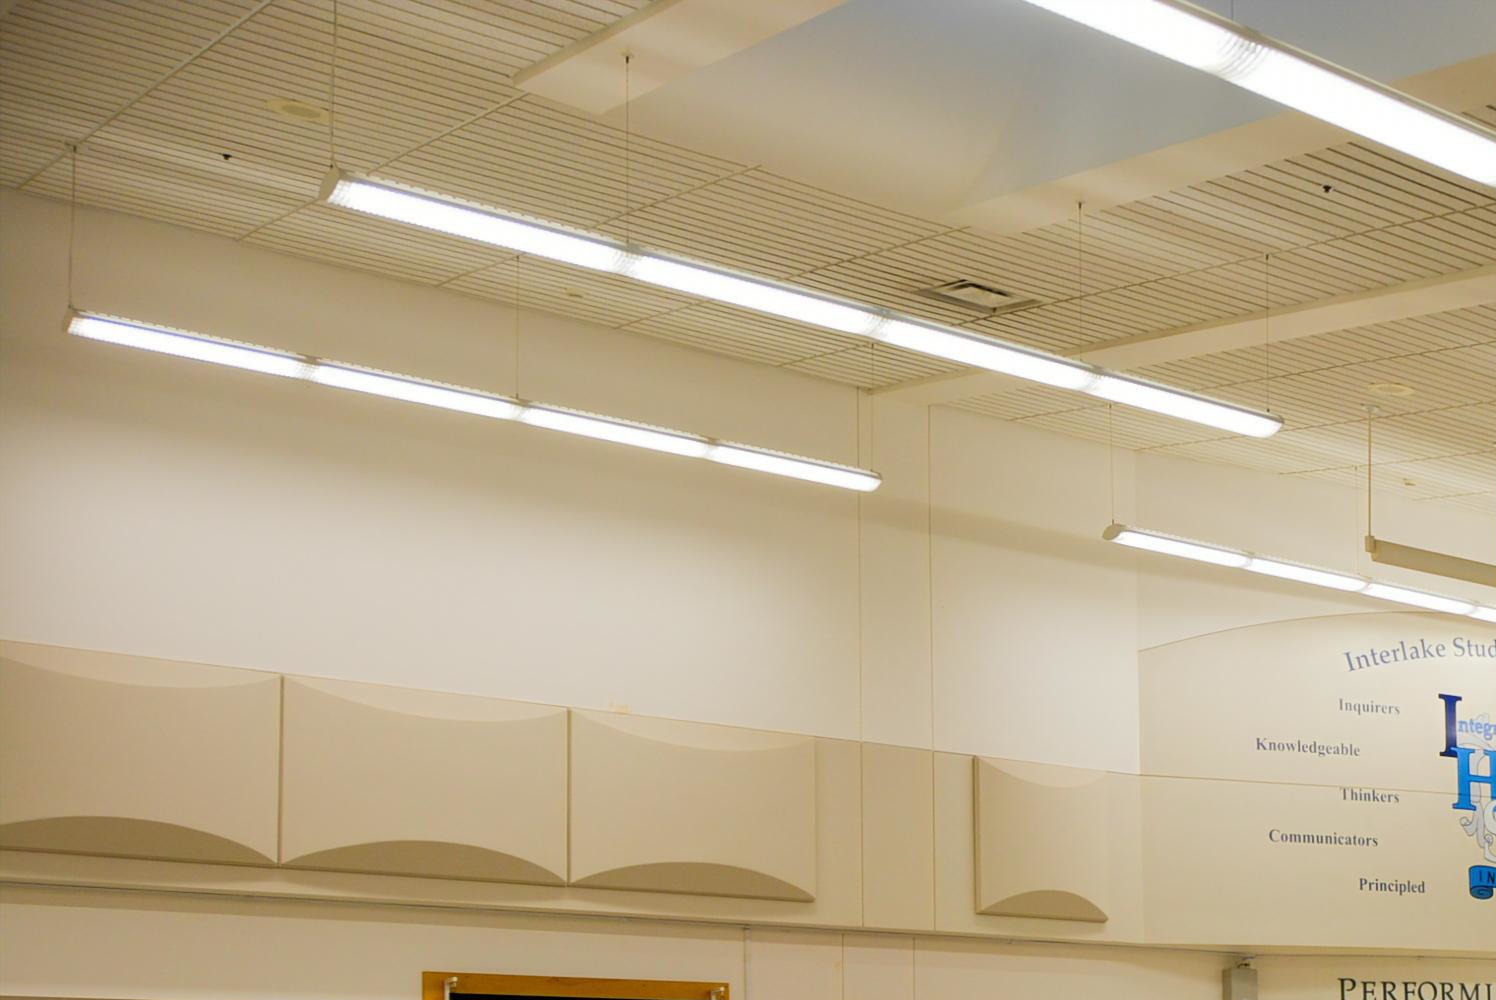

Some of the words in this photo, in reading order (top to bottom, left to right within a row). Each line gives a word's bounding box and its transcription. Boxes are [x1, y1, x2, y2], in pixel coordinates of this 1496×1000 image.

[1345, 638, 1446, 672] Interlake
[1339, 699, 1401, 716] Inquirers
[1255, 737, 1361, 757] Knowledgeable
[1340, 787, 1401, 804] Thinkers
[1268, 828, 1379, 848] Communicators
[1359, 876, 1426, 894] Principled
